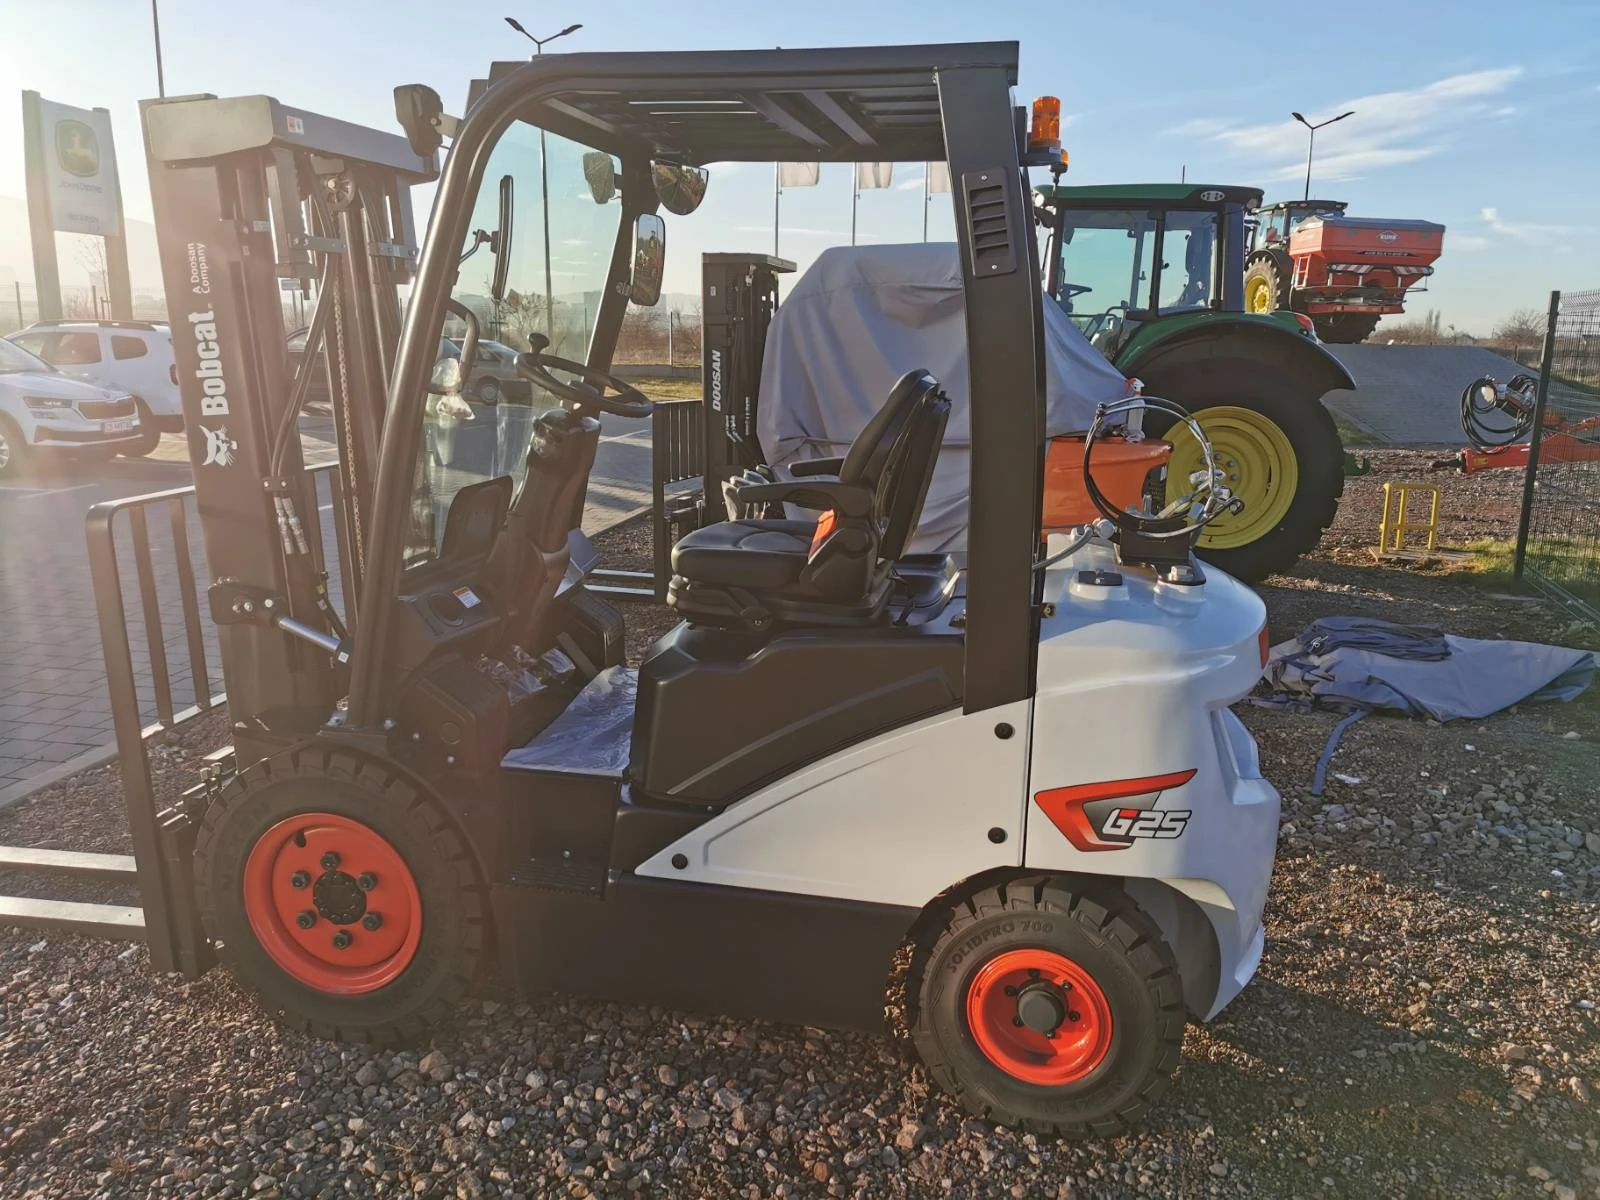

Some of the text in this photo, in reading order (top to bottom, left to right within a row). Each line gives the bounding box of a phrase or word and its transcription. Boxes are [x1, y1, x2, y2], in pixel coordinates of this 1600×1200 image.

[187, 243, 201, 294] A Doosan
[196, 243, 210, 294] Company
[188, 310, 230, 415] Bobcat
[711, 349, 721, 412] DOOSAN
[1101, 808, 1192, 839] G25
[946, 920, 1055, 974] SOLIDPRO 700
